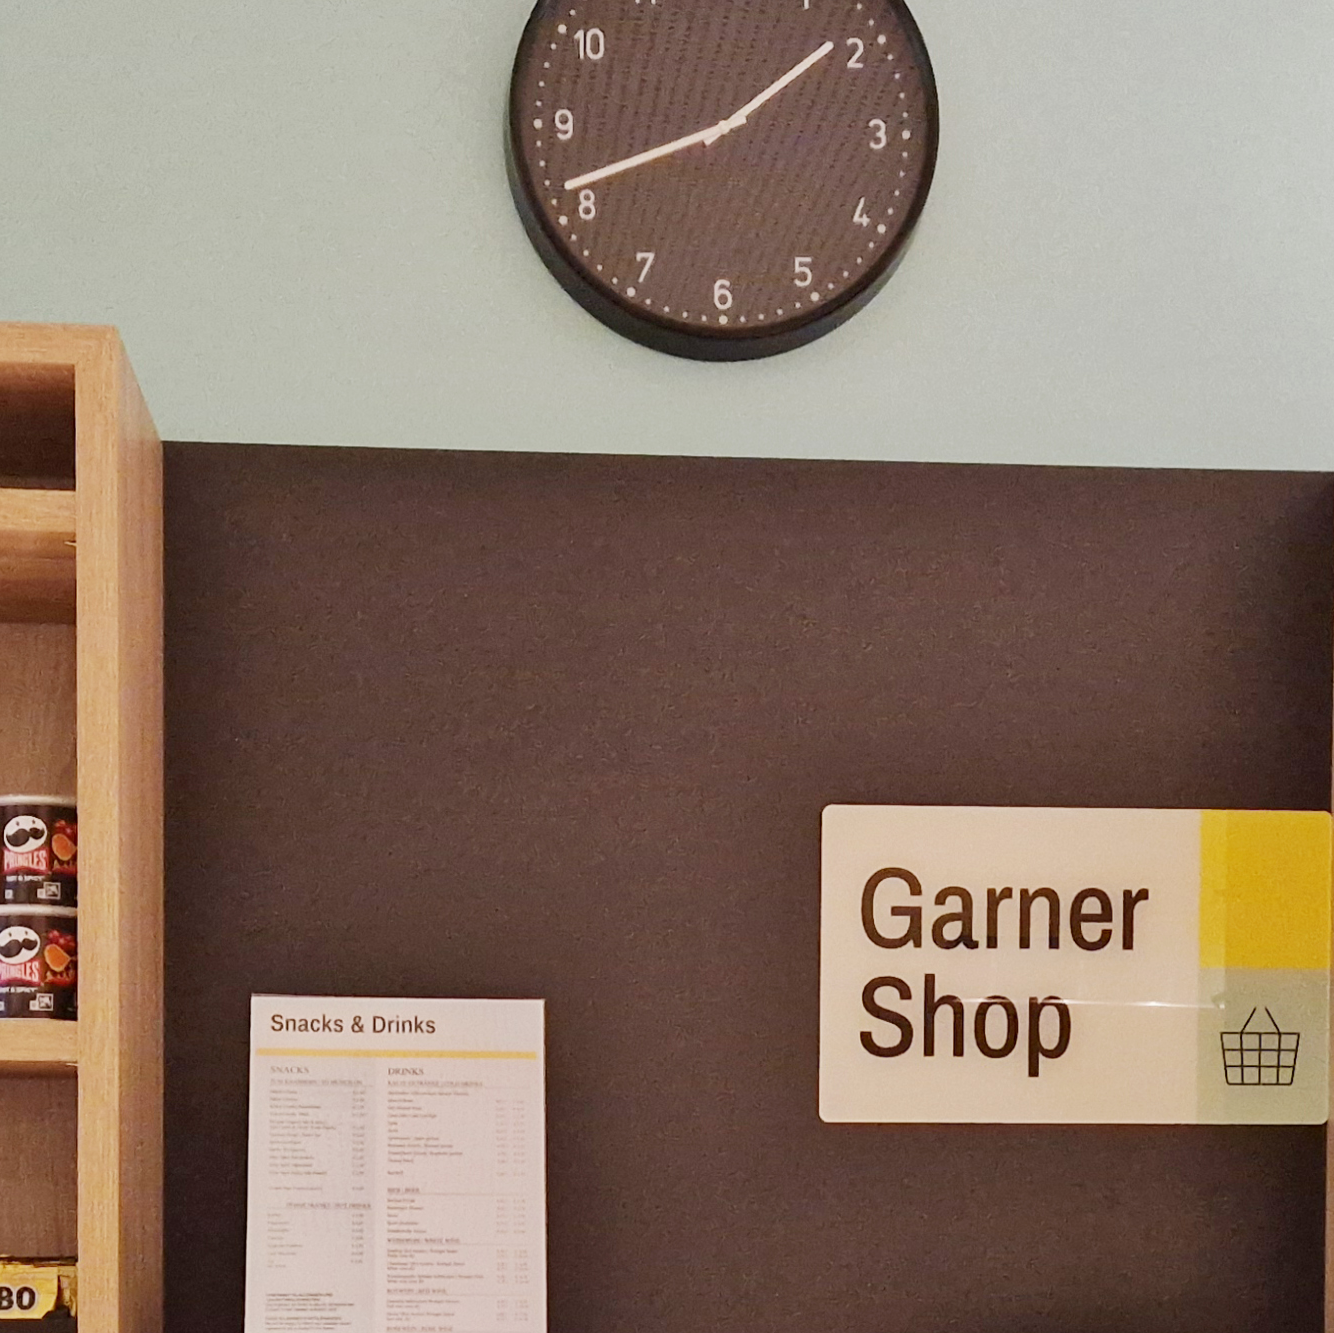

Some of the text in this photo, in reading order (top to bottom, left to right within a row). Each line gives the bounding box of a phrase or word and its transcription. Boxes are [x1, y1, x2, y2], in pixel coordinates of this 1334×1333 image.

[573, 27, 605, 61] 10
[845, 37, 864, 69] 2
[554, 108, 574, 141] 9
[868, 118, 887, 150] 3
[578, 189, 597, 221] 8
[852, 197, 870, 227] 4
[635, 252, 655, 283] 7
[793, 257, 813, 287] 5
[713, 279, 733, 310] 6
[4, 849, 48, 872] PRINGLES
[860, 867, 1150, 952] Garner
[271, 1014, 437, 1034] Snacks & Drinks
[859, 973, 1072, 1078] Shop
[387, 1067, 425, 1076] DRINKS
